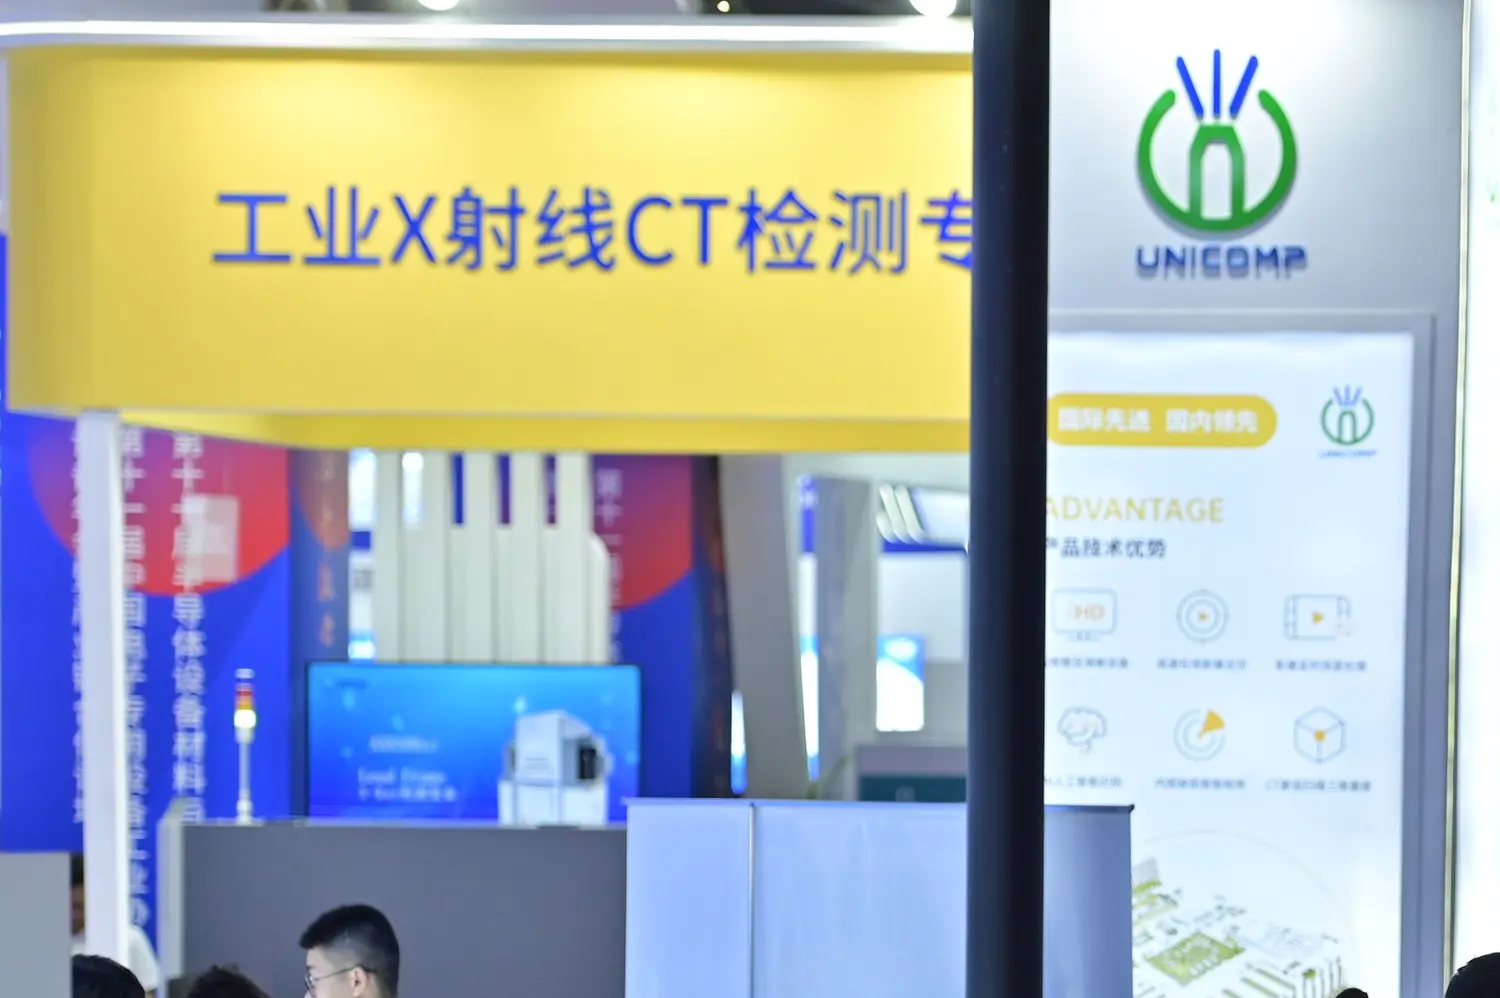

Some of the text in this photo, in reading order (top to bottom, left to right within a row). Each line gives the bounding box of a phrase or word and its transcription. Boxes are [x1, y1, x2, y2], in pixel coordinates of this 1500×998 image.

[212, 185, 972, 274] 工业X射线CT检测专
[1136, 245, 1307, 277] UNICOMP
[1045, 495, 1225, 523] ADVANTAGE
